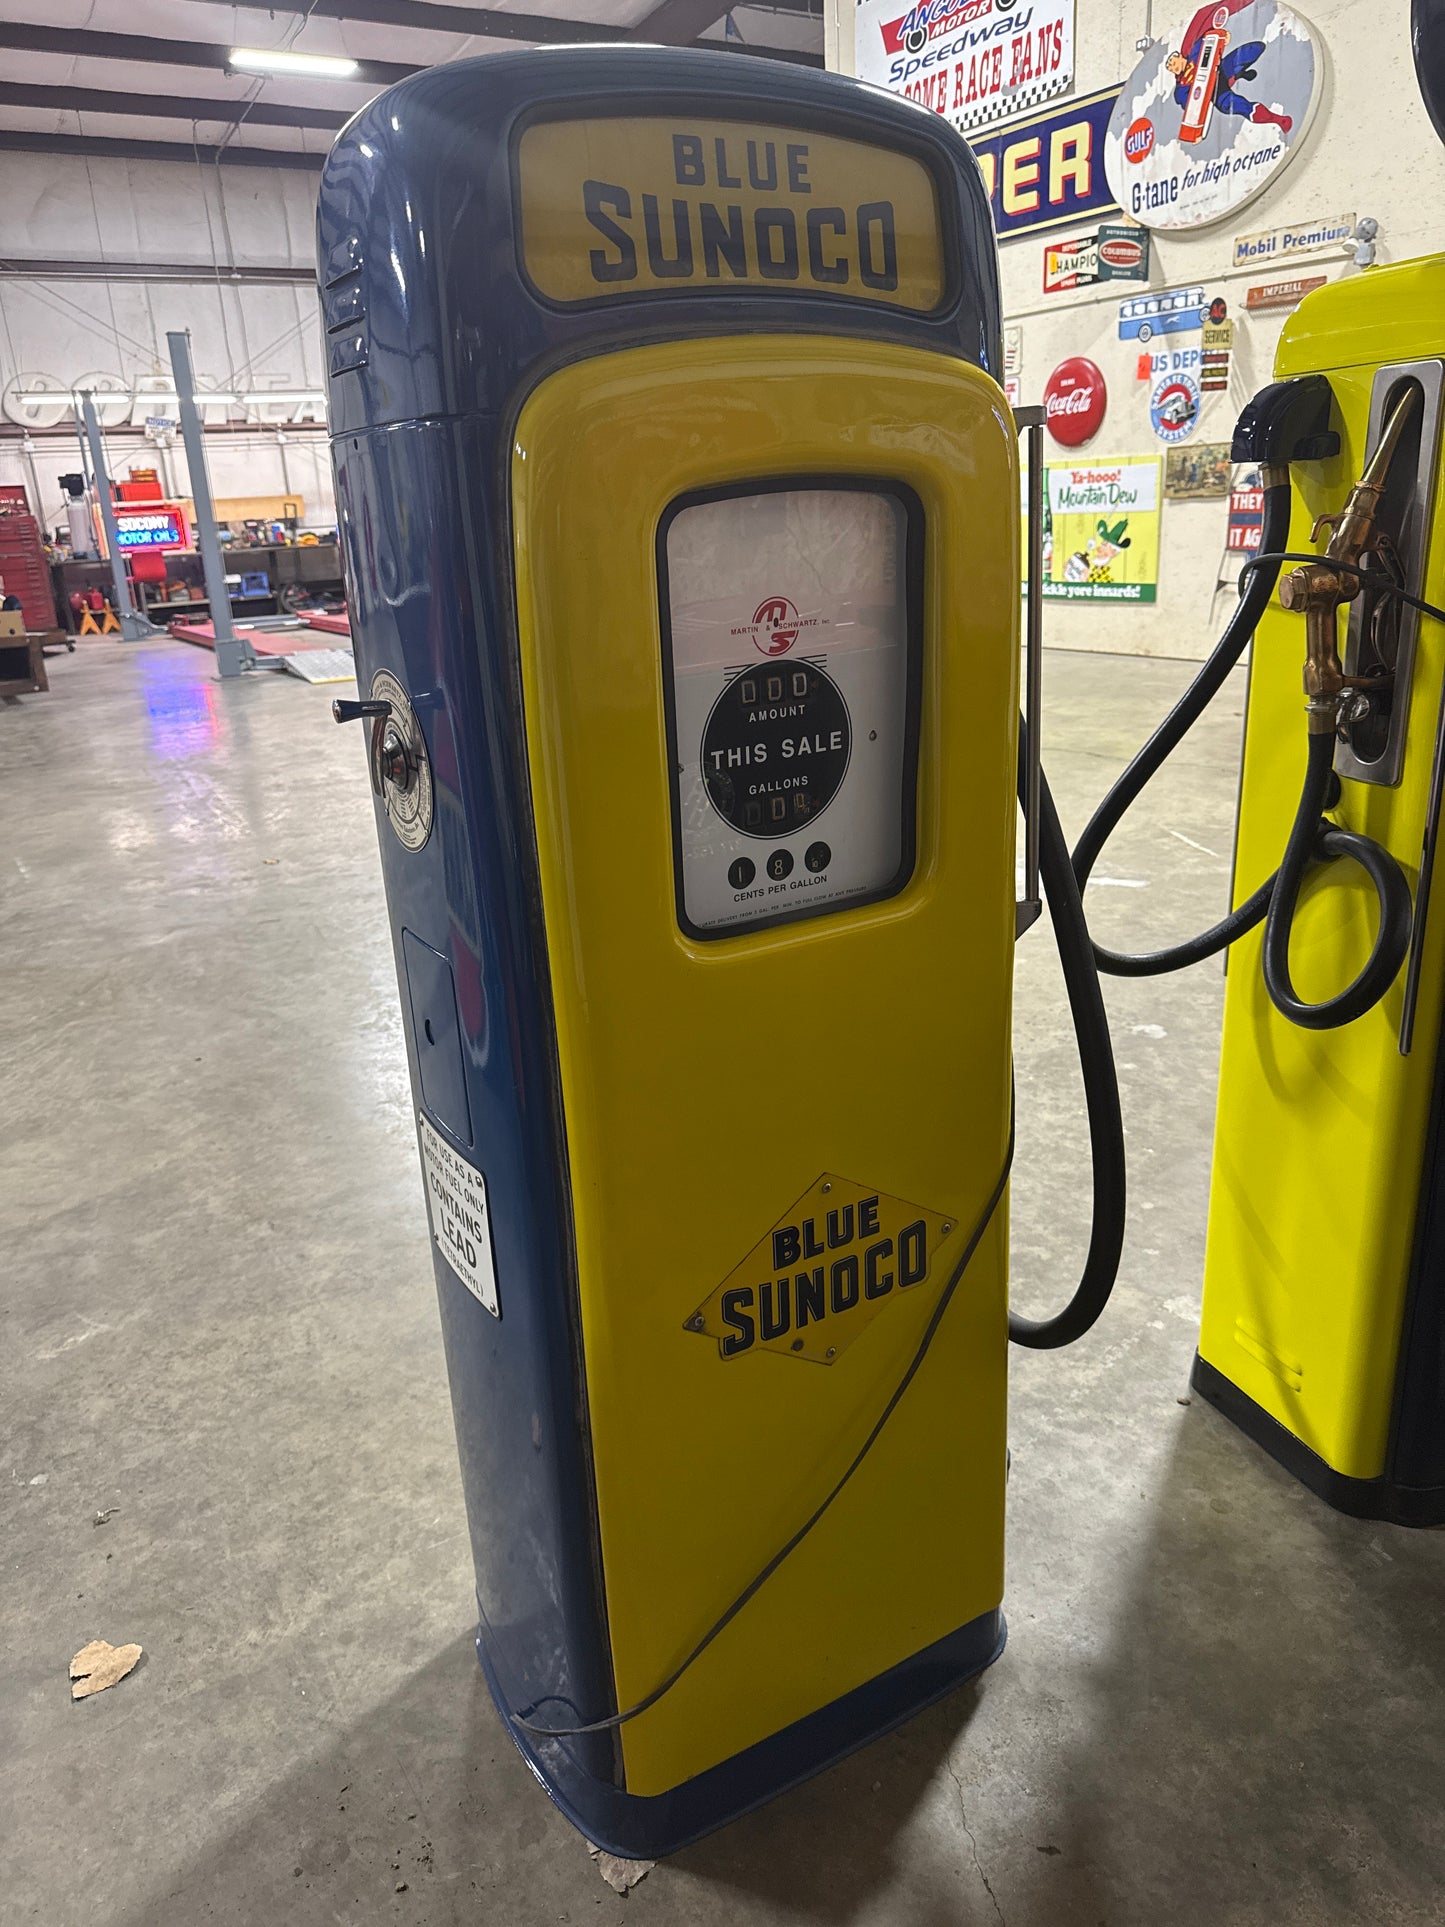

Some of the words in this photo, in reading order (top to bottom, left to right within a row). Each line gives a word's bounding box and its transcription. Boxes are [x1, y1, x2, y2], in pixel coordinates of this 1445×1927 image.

[930, 3, 990, 38] MOTOR
[889, 7, 1034, 83] Speedway
[952, 45, 1003, 109] RACE
[1009, 17, 1064, 88] FANS
[1127, 127, 1153, 154] GULF
[672, 133, 812, 194] BLUE
[1181, 169, 1201, 191] for
[1200, 155, 1231, 184] high
[1232, 144, 1281, 171] octane
[582, 179, 899, 292] SUNOCO
[1237, 237, 1276, 258] Mobil
[1283, 225, 1351, 249] Premium
[1053, 253, 1098, 275] HAMPIO
[1262, 282, 1302, 297] IMPERIAL
[1210, 303, 1226, 318] AC
[1204, 329, 1230, 344] SERVICE
[1151, 355, 1168, 373] US
[1047, 386, 1095, 417] Coca-Cola
[1071, 469, 1122, 484] Ya-hooo!
[1058, 485, 1107, 509] Mountain
[1106, 483, 1137, 504] Dew
[1232, 492, 1263, 510] THEY
[153, 529, 179, 543] OILS
[1229, 528, 1243, 547] IT
[1042, 583, 1067, 596] ickle
[1093, 584, 1141, 598] innards!
[730, 626, 759, 635] MARTIN
[749, 704, 806, 723] AMOUNT
[711, 743, 768, 770] THIS
[781, 731, 842, 758] SALE
[748, 776, 809, 795] GALLONS
[733, 889, 765, 903] CENTS
[768, 884, 786, 895] PER
[789, 875, 828, 890] GALLON
[427, 1128, 438, 1152] FOR
[439, 1143, 453, 1168] USE
[455, 1160, 465, 1179] AS
[468, 1172, 474, 1188] A
[424, 1142, 443, 1175] MOTOR
[445, 1168, 463, 1196] FUEL
[464, 1188, 484, 1214] ONLY
[430, 1171, 482, 1244] CONTAINS
[440, 1207, 477, 1269] LEAD
[772, 1195, 880, 1271] BLUE
[441, 1237, 484, 1297] (TETRAETHYL)
[721, 1219, 926, 1356] SUNOCO
